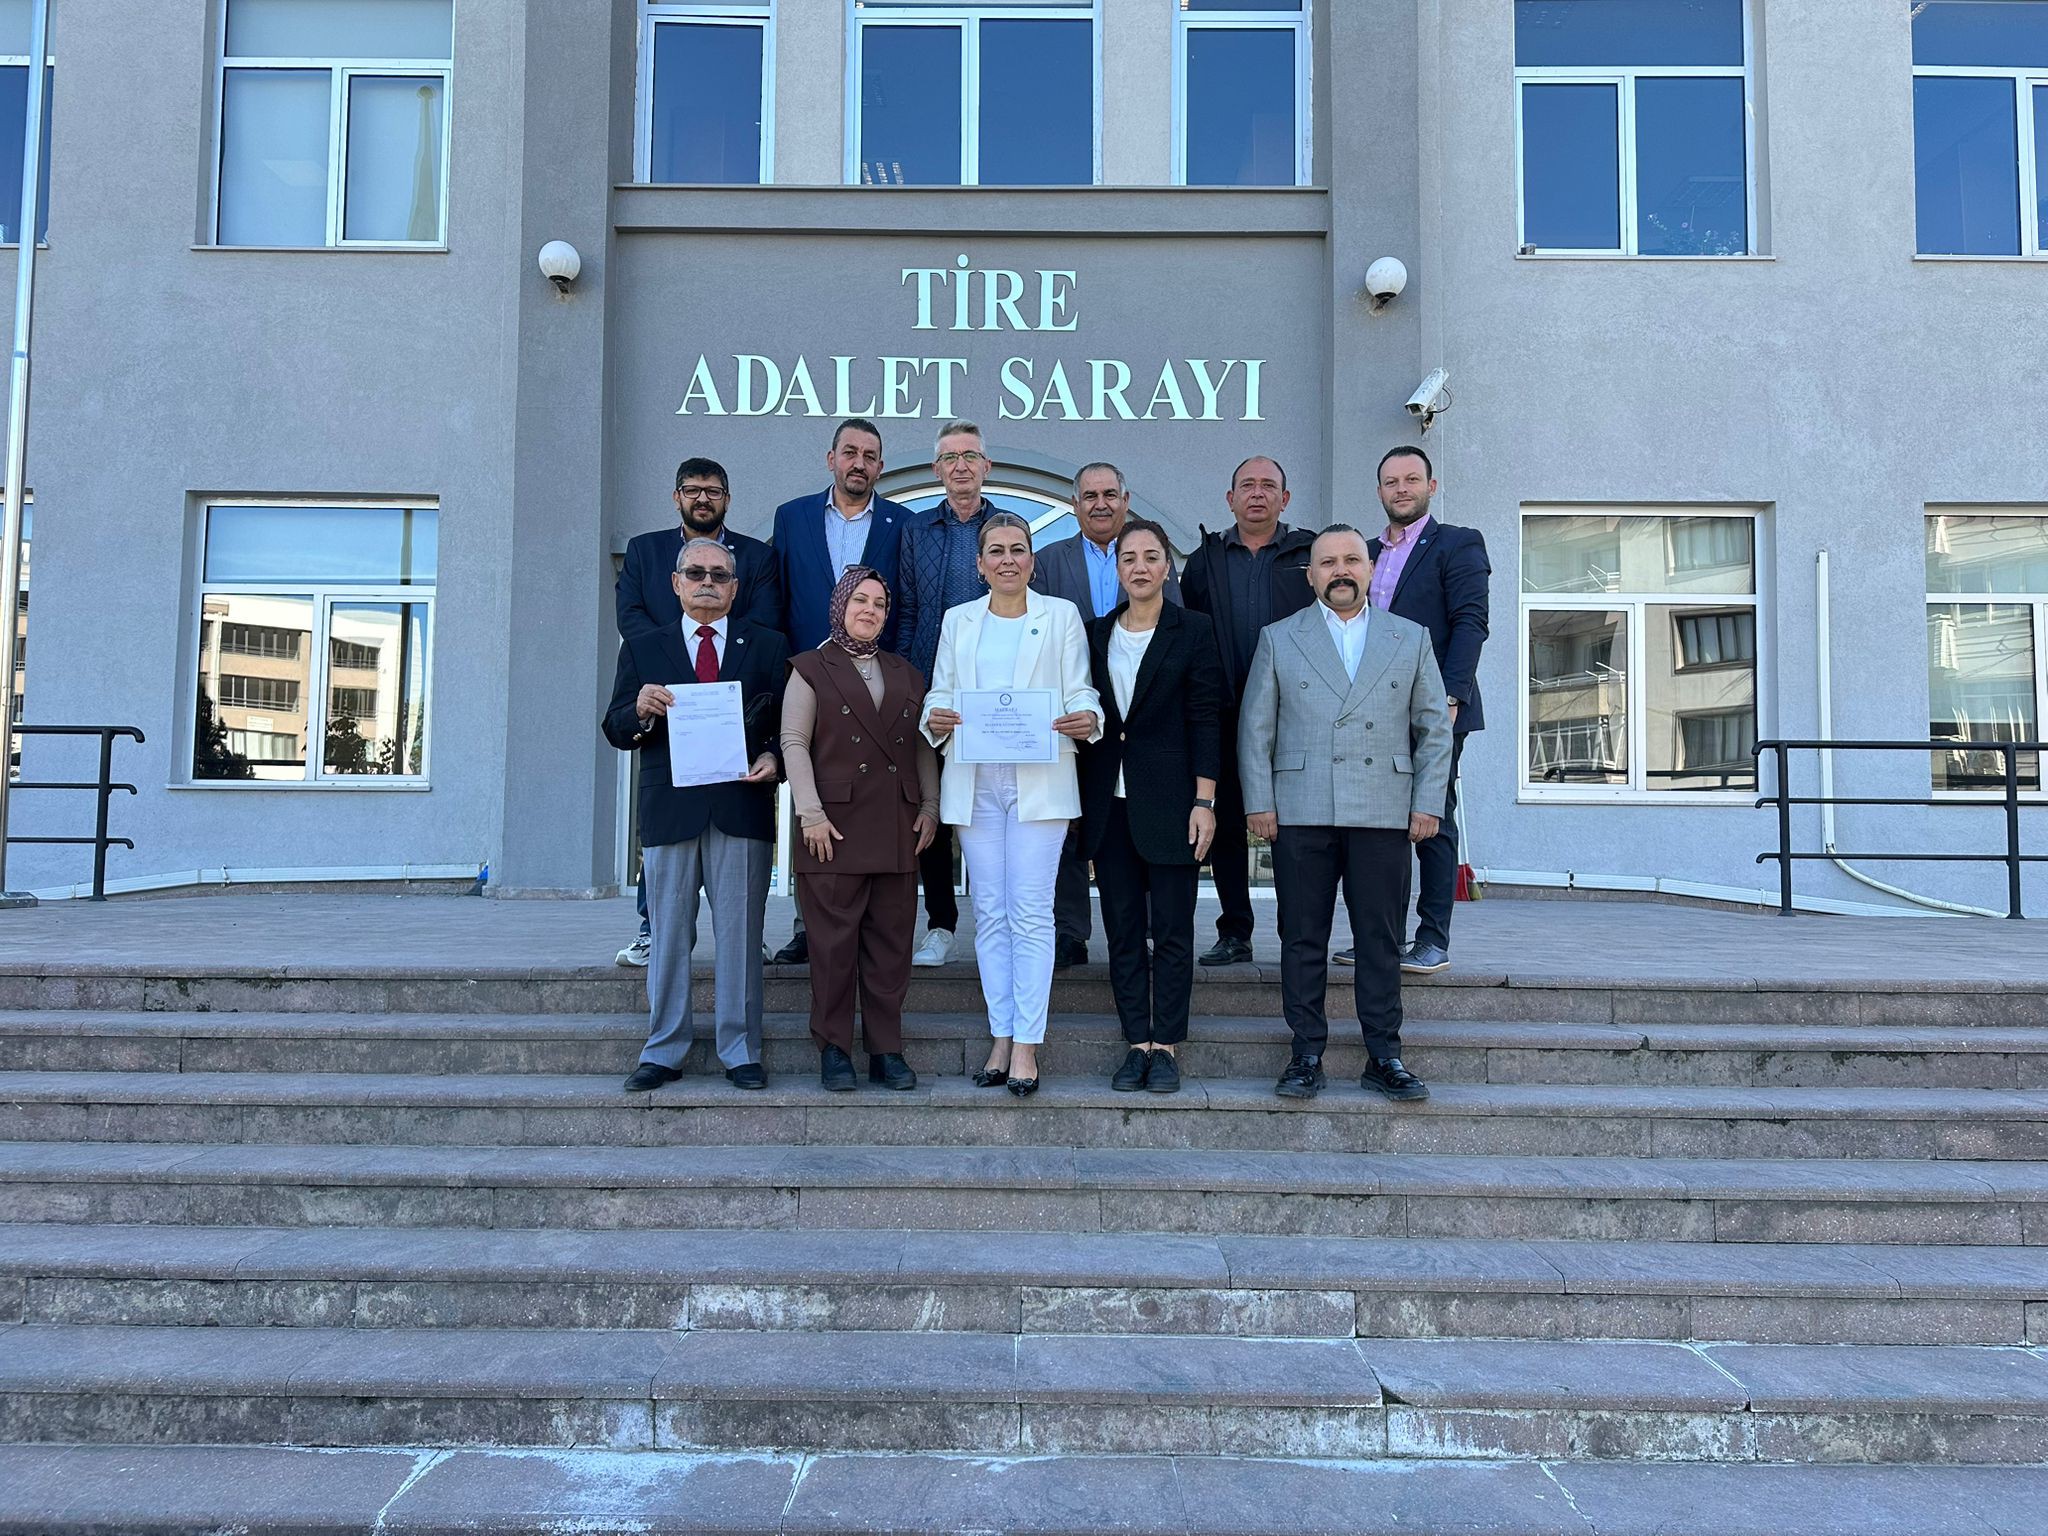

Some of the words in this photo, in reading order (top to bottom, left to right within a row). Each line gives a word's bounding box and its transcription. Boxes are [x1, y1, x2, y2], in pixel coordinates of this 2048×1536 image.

[901, 253, 1079, 332] TİRE
[675, 353, 968, 420] ADALET
[998, 356, 1267, 421] SARAYI
